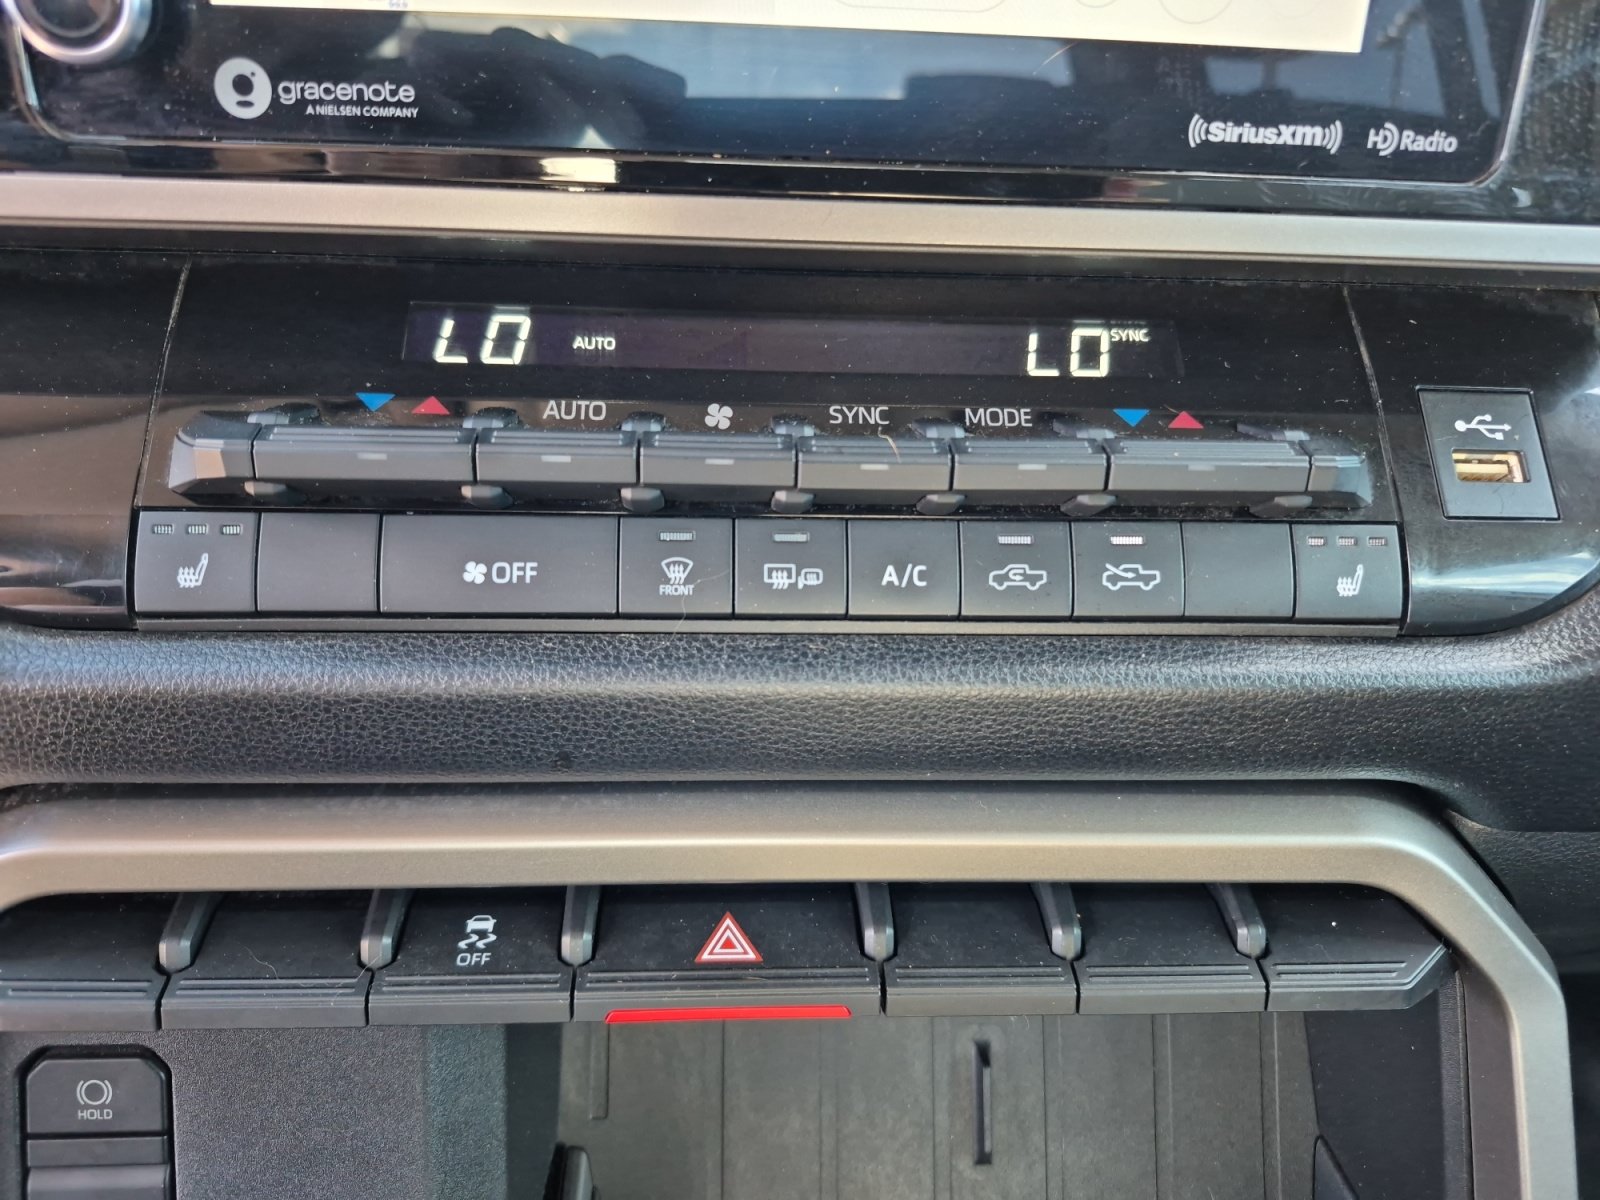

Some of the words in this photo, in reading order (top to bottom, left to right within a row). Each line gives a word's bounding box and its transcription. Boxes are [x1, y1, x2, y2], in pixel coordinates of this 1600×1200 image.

[277, 80, 416, 105] gracenote
[305, 104, 315, 115] A
[316, 104, 361, 117] NIELSEN
[362, 105, 419, 118] COMPANY
[1367, 124, 1398, 155] HD
[1400, 129, 1458, 153] Radio
[572, 335, 616, 351] AUTO
[1110, 327, 1149, 342] SYNC
[541, 399, 606, 421] AUTO
[829, 405, 890, 425] SYNC
[965, 407, 1033, 428] MODE
[491, 561, 538, 584] OFF
[881, 564, 927, 588] A/C
[659, 584, 695, 596] FRONT
[455, 952, 492, 967] OFF
[77, 1108, 113, 1120] HOLD
